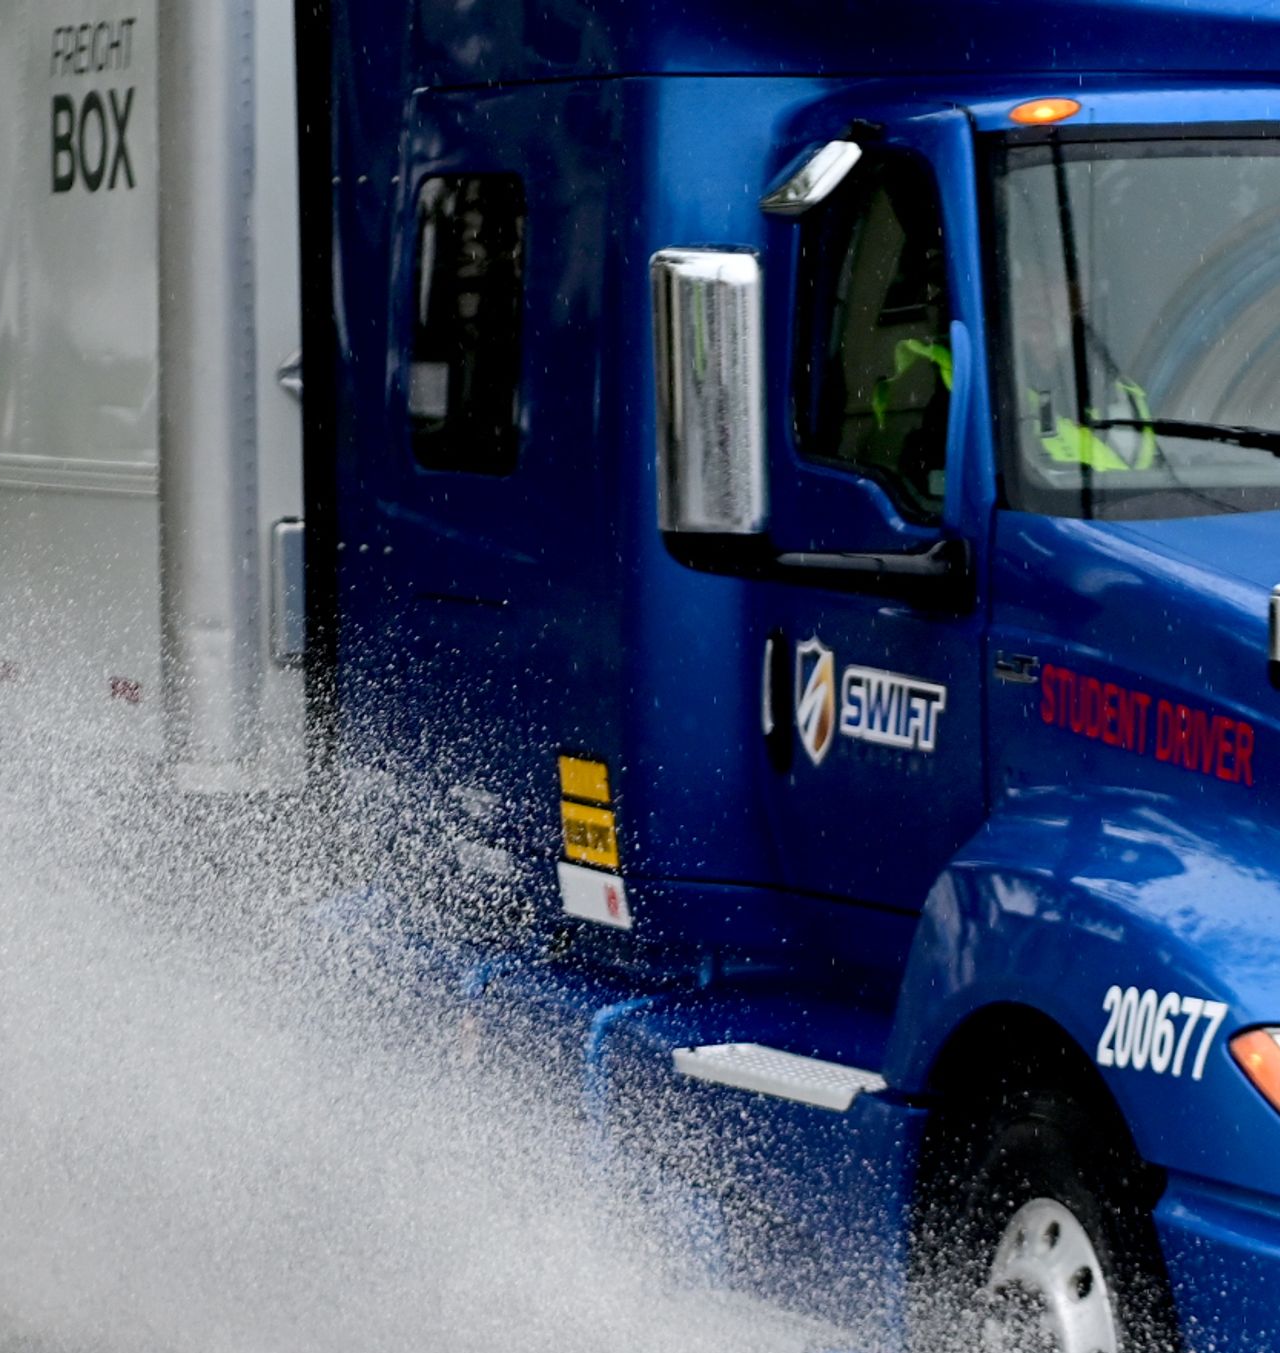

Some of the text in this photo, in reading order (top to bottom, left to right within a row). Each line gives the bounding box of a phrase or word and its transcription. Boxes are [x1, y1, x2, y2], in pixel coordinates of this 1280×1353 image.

[50, 17, 137, 78] FREIGHT
[51, 86, 136, 193] BOX
[841, 668, 945, 749] SWIFT
[1040, 662, 1255, 787] STUDENT DRIVER
[1097, 984, 1229, 1081] 200677
